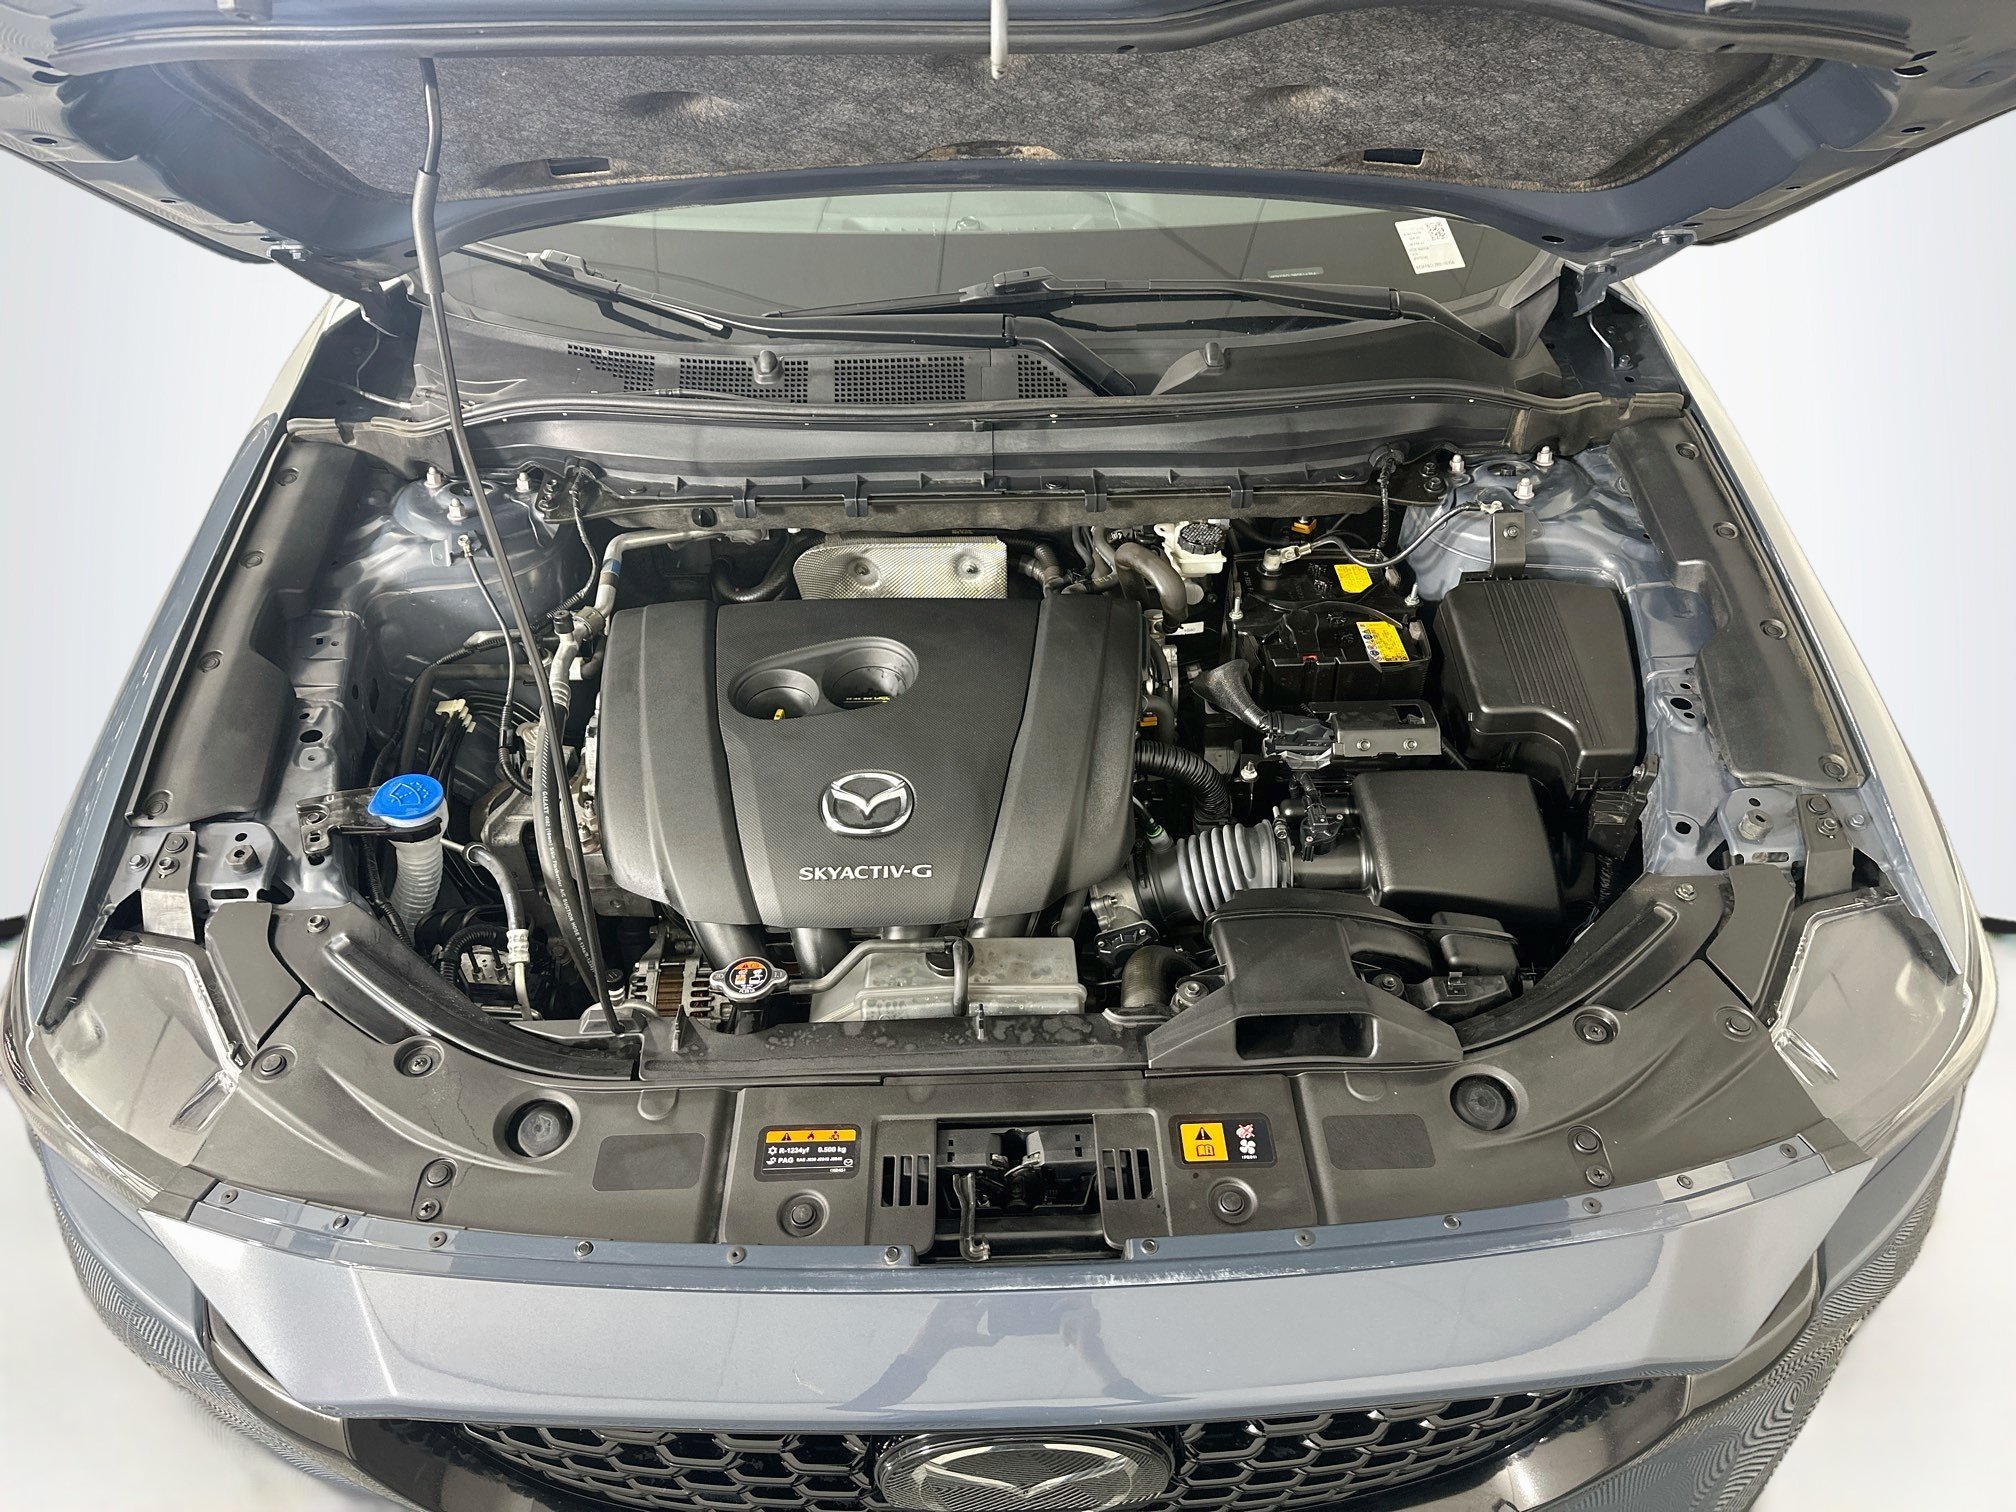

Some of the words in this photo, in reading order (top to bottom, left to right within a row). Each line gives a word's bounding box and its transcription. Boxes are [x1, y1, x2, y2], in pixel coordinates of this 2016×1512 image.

[799, 864, 933, 880] SKYACTIV-G
[562, 898, 574, 921] SUCTION
[571, 922, 580, 936] HOSE
[778, 1146, 810, 1154] R-1234yf
[837, 1146, 847, 1154] kg
